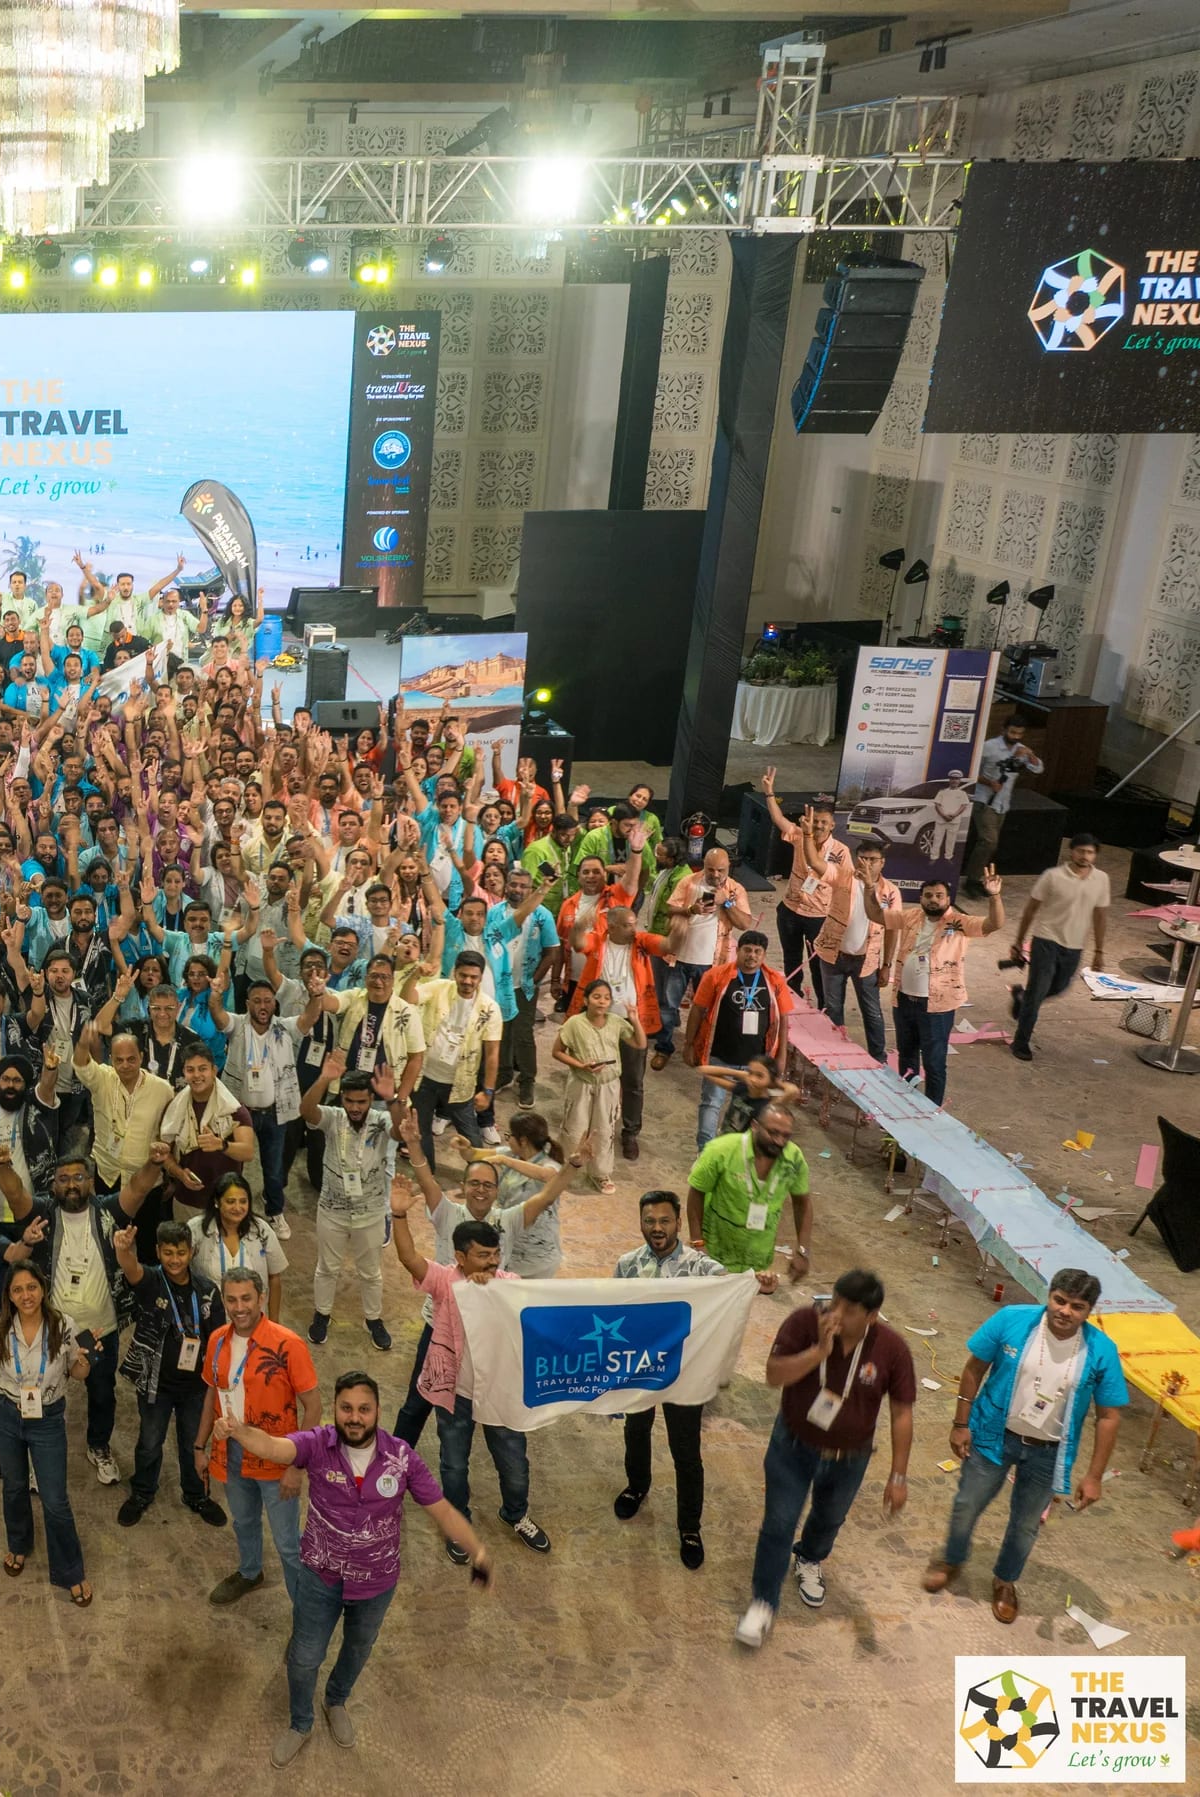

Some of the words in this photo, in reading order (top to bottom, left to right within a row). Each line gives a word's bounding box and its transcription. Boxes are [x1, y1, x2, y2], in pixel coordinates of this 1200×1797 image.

[1145, 250, 1199, 273] THE
[1140, 277, 1200, 300] TRA
[398, 340, 427, 348] NEXUS
[399, 332, 430, 340] TRAVEL
[1122, 330, 1164, 350] Let's
[1, 379, 64, 404] THE
[365, 382, 426, 393] travelUrze
[0, 409, 128, 435] TRAVEL
[1, 440, 113, 467] NEXUS
[51, 479, 102, 502] grow
[212, 512, 250, 569] PARAKRAM
[535, 1352, 598, 1378] BLUE
[536, 1377, 580, 1389] TRAVEL
[585, 1375, 610, 1383] AND
[568, 1386, 590, 1394] DMC
